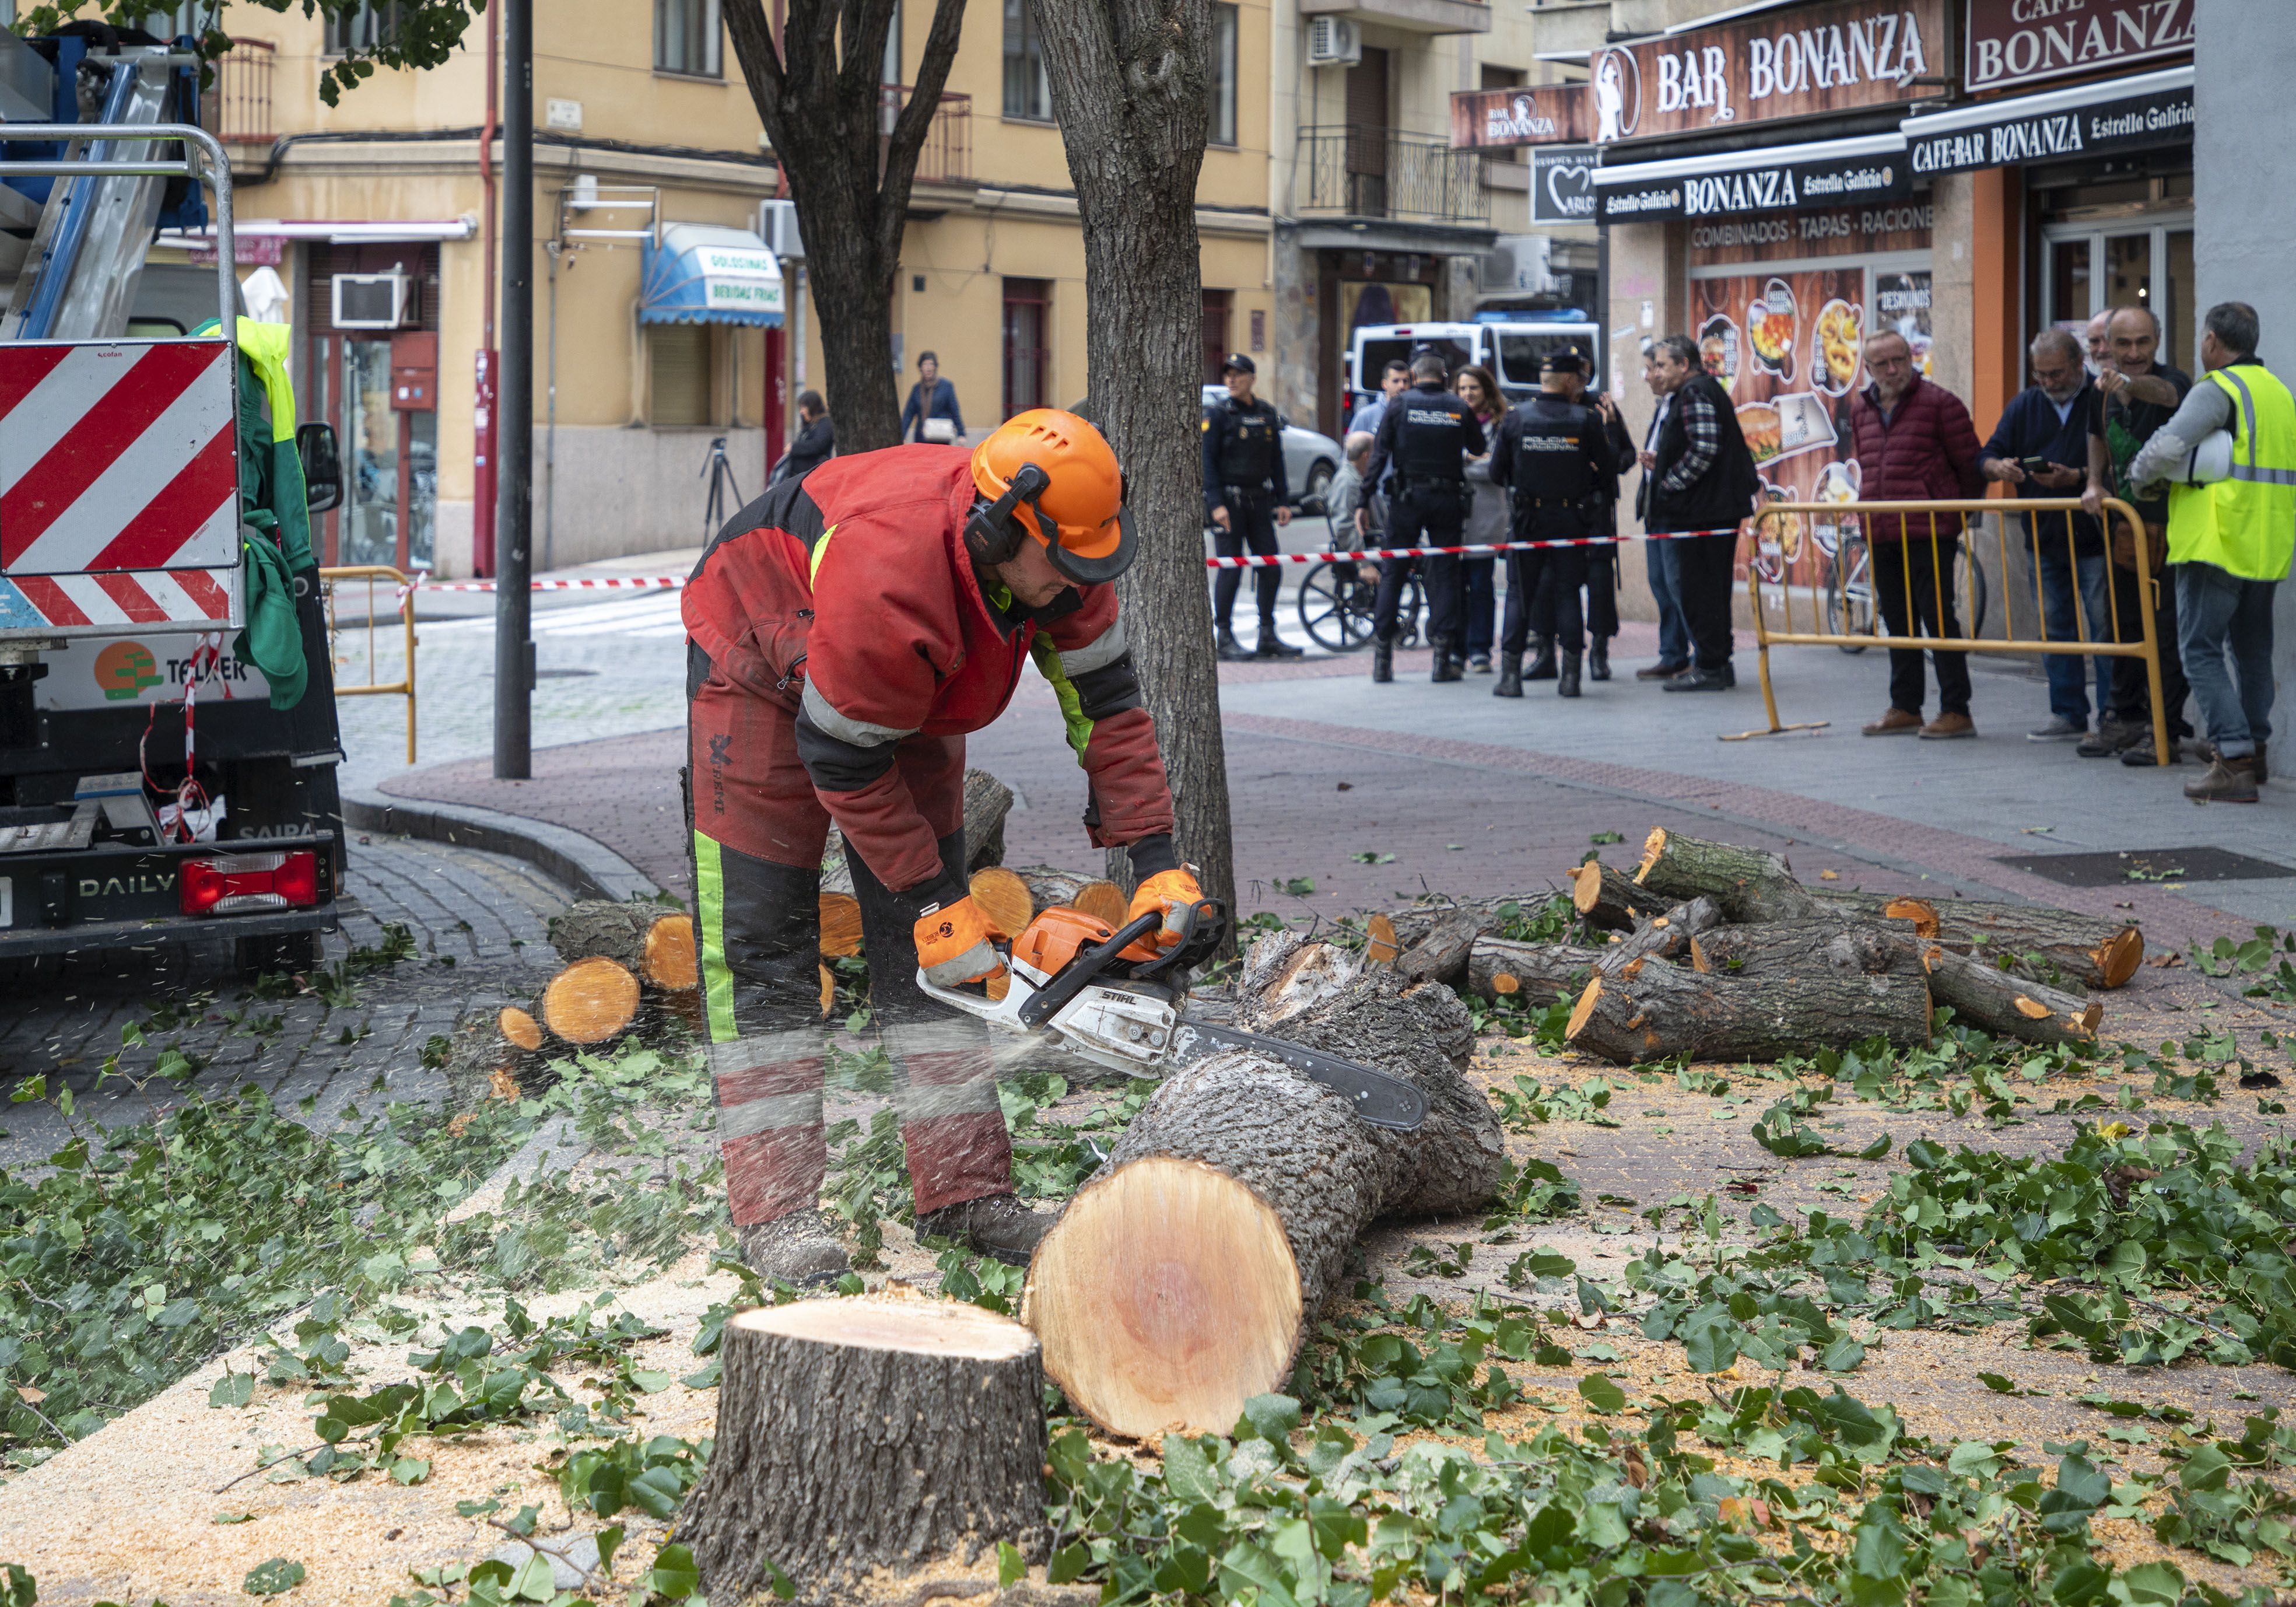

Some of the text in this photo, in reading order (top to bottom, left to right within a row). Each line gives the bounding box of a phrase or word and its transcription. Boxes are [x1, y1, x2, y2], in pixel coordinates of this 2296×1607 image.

[1656, 10, 1927, 125] BAR BONANZA
[1488, 107, 1509, 121] BAR
[1487, 117, 1556, 139] BONANZA
[1912, 100, 2195, 173] CAFE-BAR BONANZA Estrella Galicia
[1606, 167, 1883, 216] Estrella Galicia BONANZA Estrella Galicia
[1692, 220, 1789, 248] COMBINADOS
[1798, 212, 1852, 240] TAPAS
[1408, 409, 1451, 418] POLICIA
[1408, 416, 1461, 426] NACIONAL
[1522, 436, 1568, 444] POLICIA
[1522, 442, 1579, 451] NACIONAL
[709, 733, 733, 816] EXTREME
[79, 873, 176, 897] DAILY
[1101, 990, 1137, 1006] STIHL
